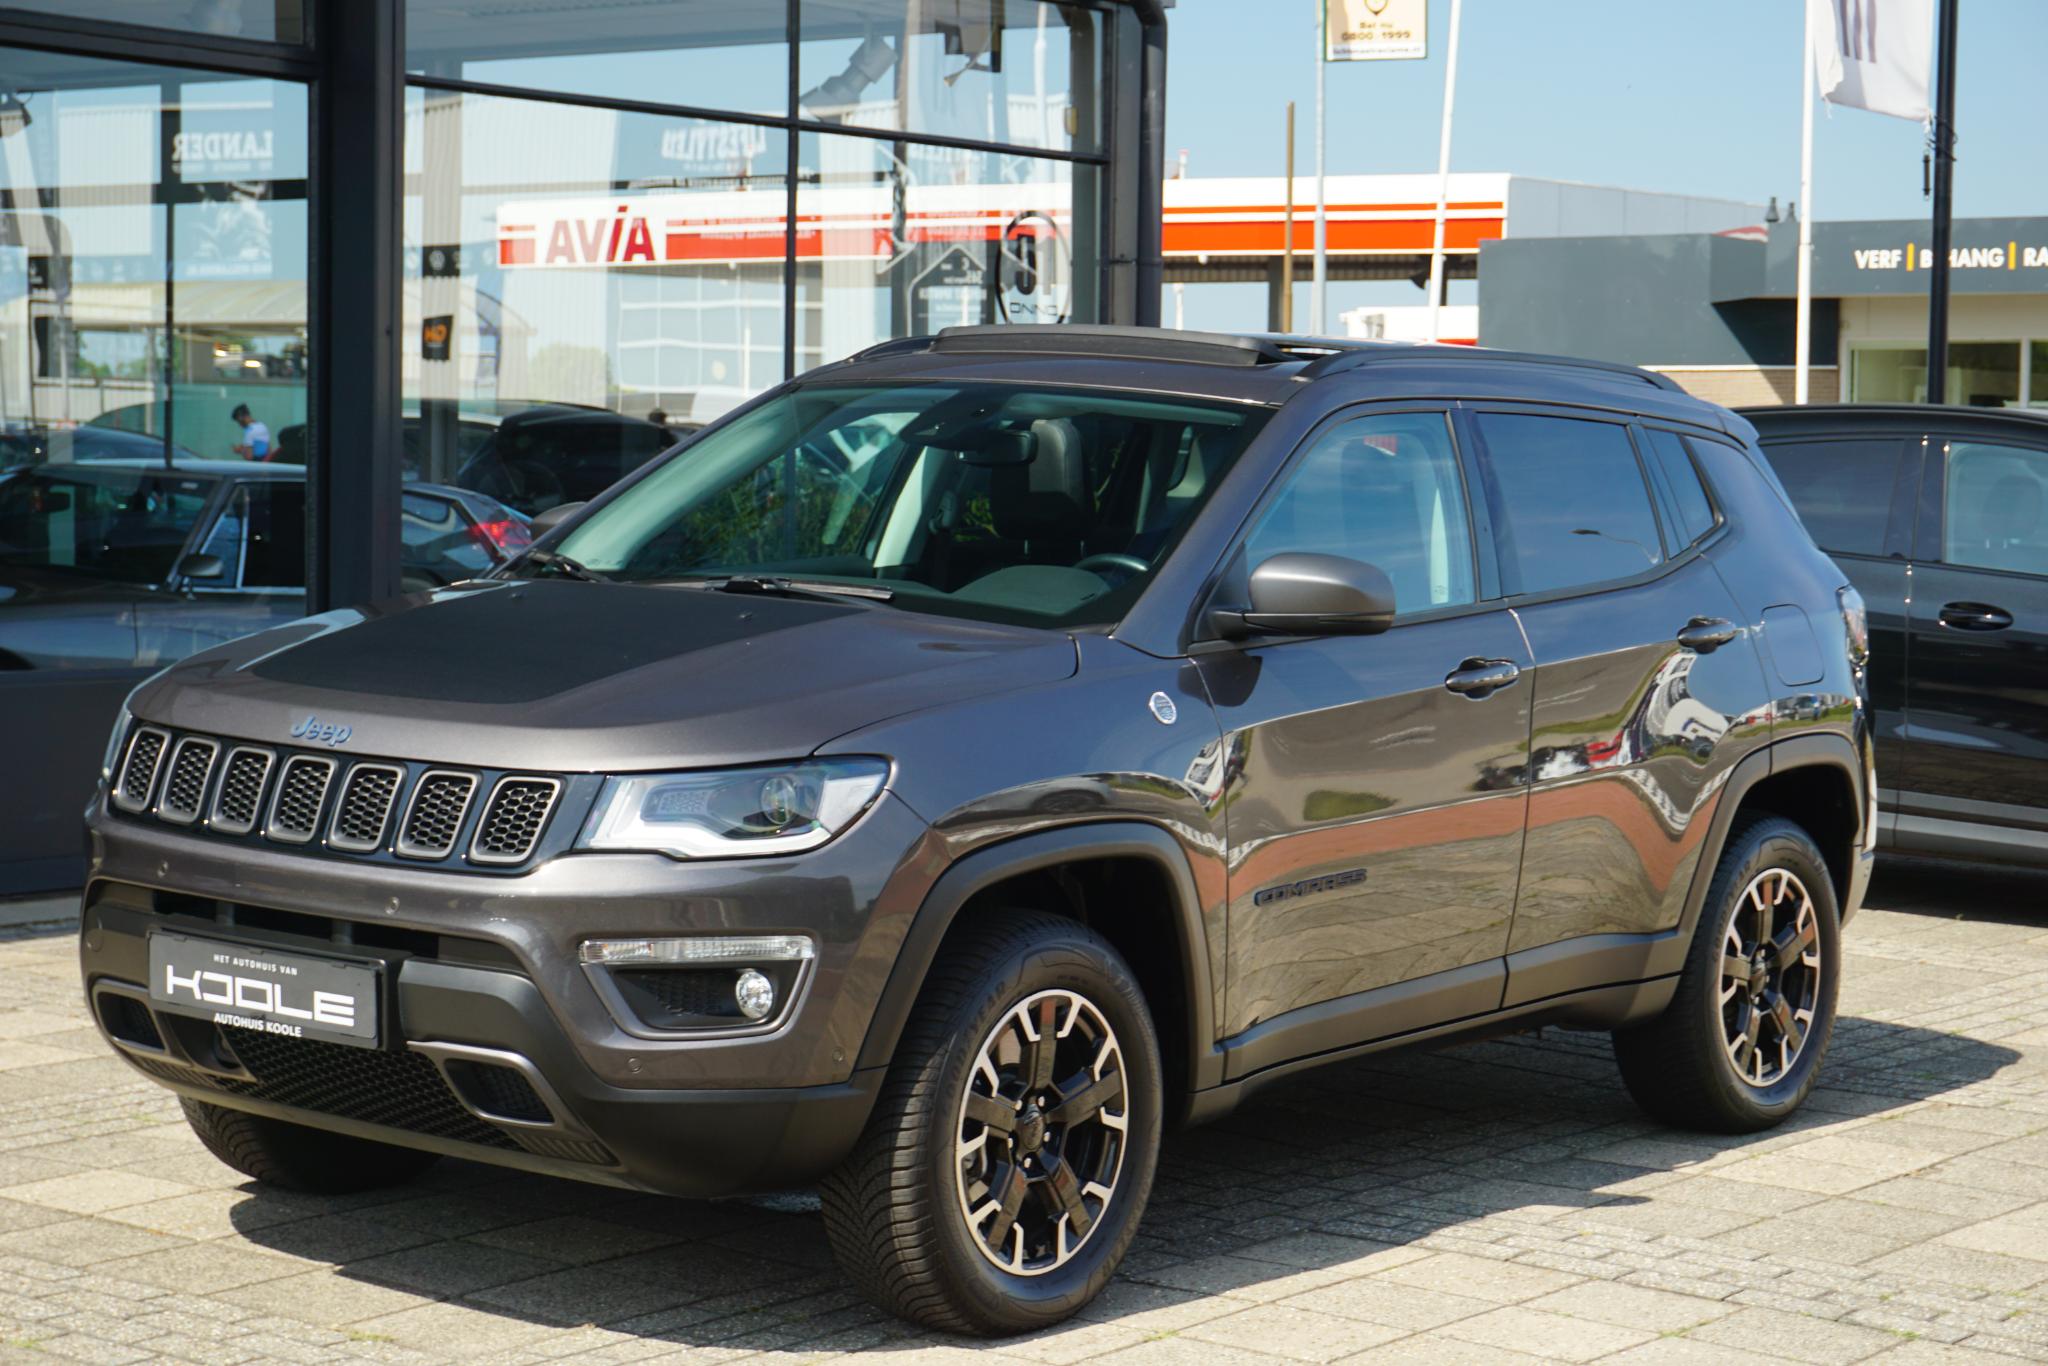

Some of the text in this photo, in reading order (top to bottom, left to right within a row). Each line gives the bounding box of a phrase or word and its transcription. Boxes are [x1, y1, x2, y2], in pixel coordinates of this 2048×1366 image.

[1854, 249, 1903, 269] VERF
[1919, 247, 2004, 269] BANG
[290, 713, 352, 747] Jeep
[213, 953, 298, 977] HET AUTOHUIS VAN
[166, 963, 355, 1028] KOOLE
[213, 1011, 302, 1038] AUTOHUIS KOOLE
